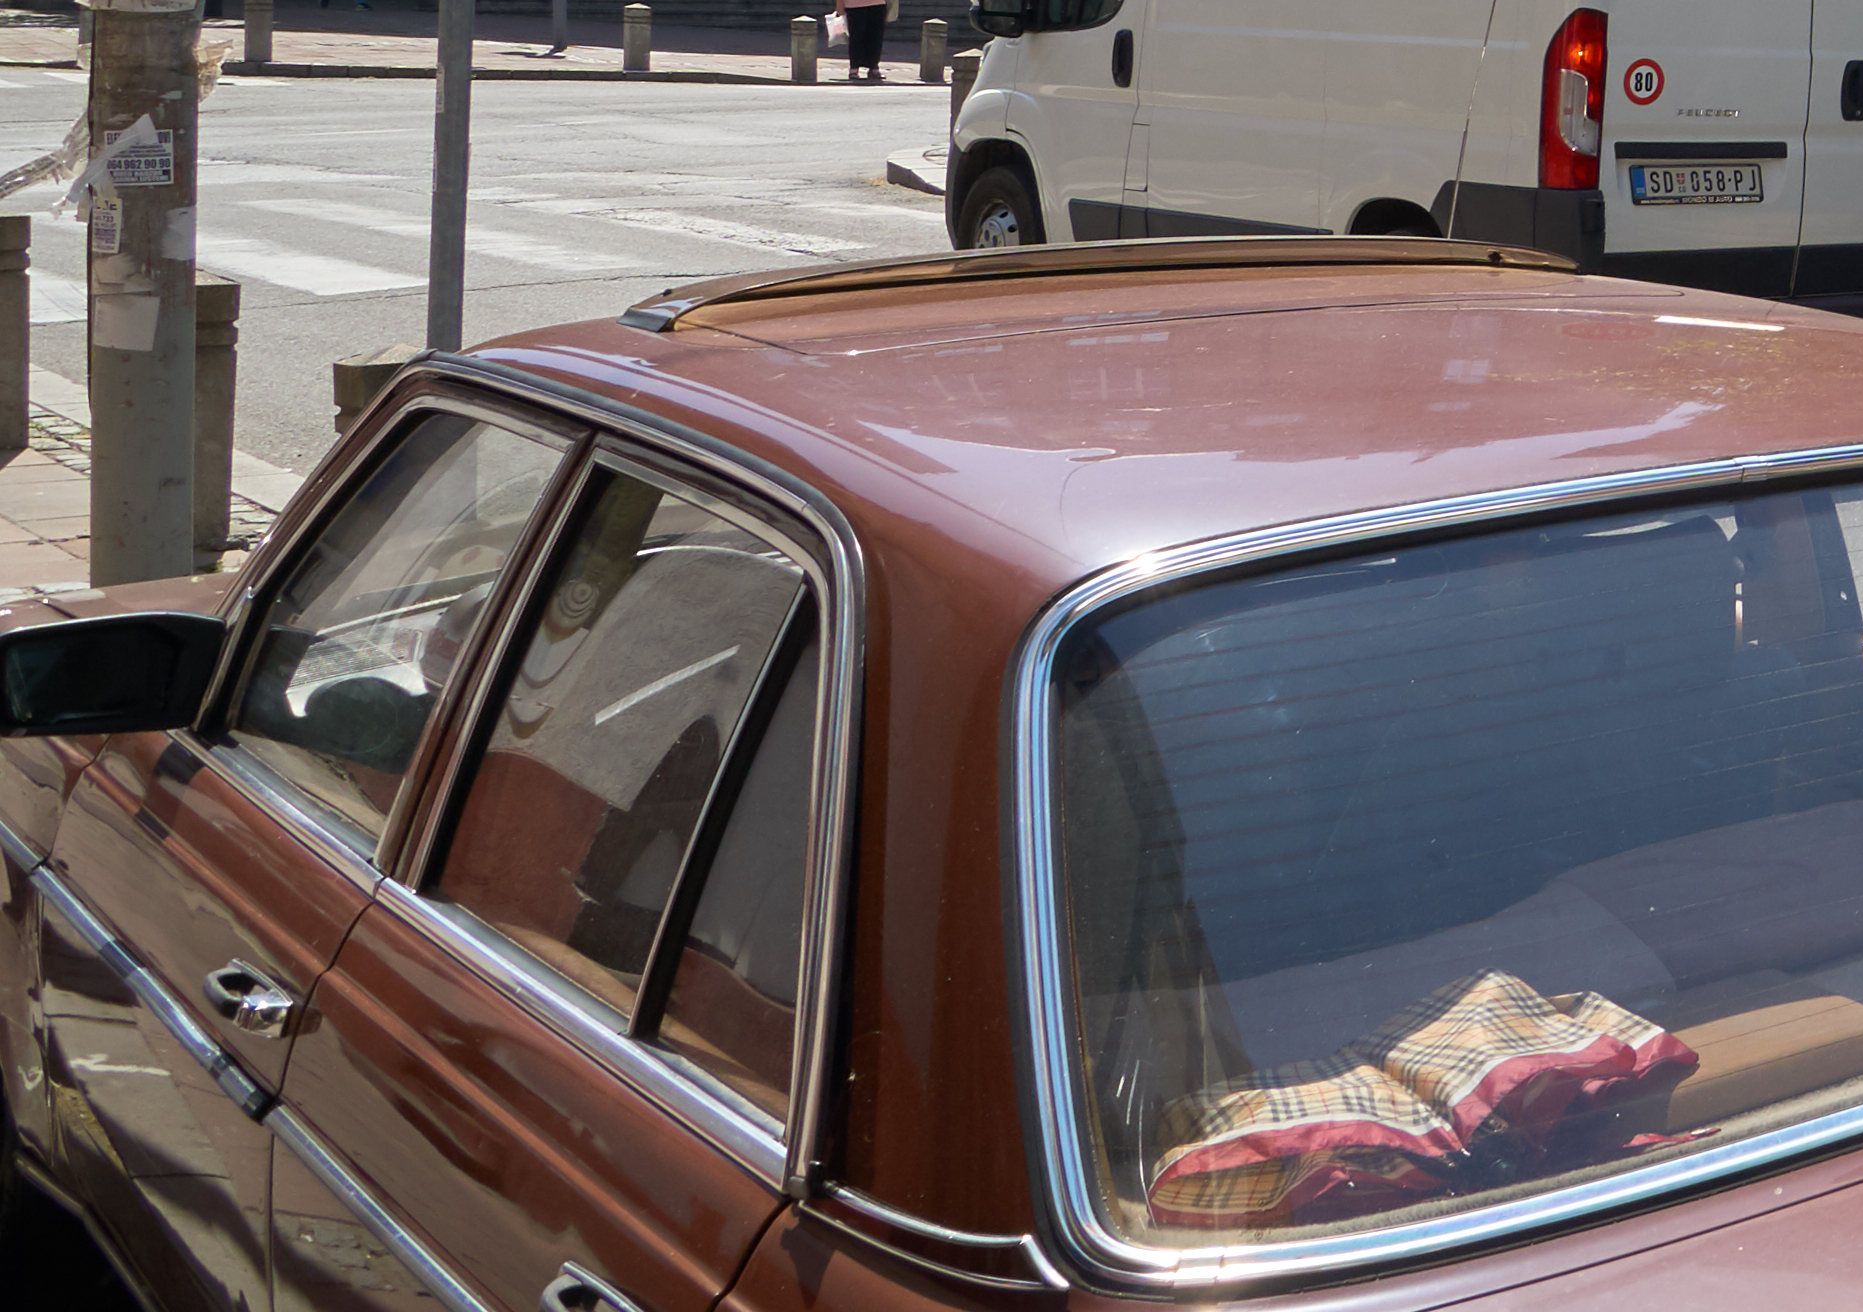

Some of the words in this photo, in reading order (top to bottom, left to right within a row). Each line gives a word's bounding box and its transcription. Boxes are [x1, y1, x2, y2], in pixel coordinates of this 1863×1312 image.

[1634, 71, 1654, 93] 80
[124, 158, 142, 170] 962
[144, 158, 157, 169] 90
[159, 157, 171, 169] 90
[1649, 170, 1674, 194] SD
